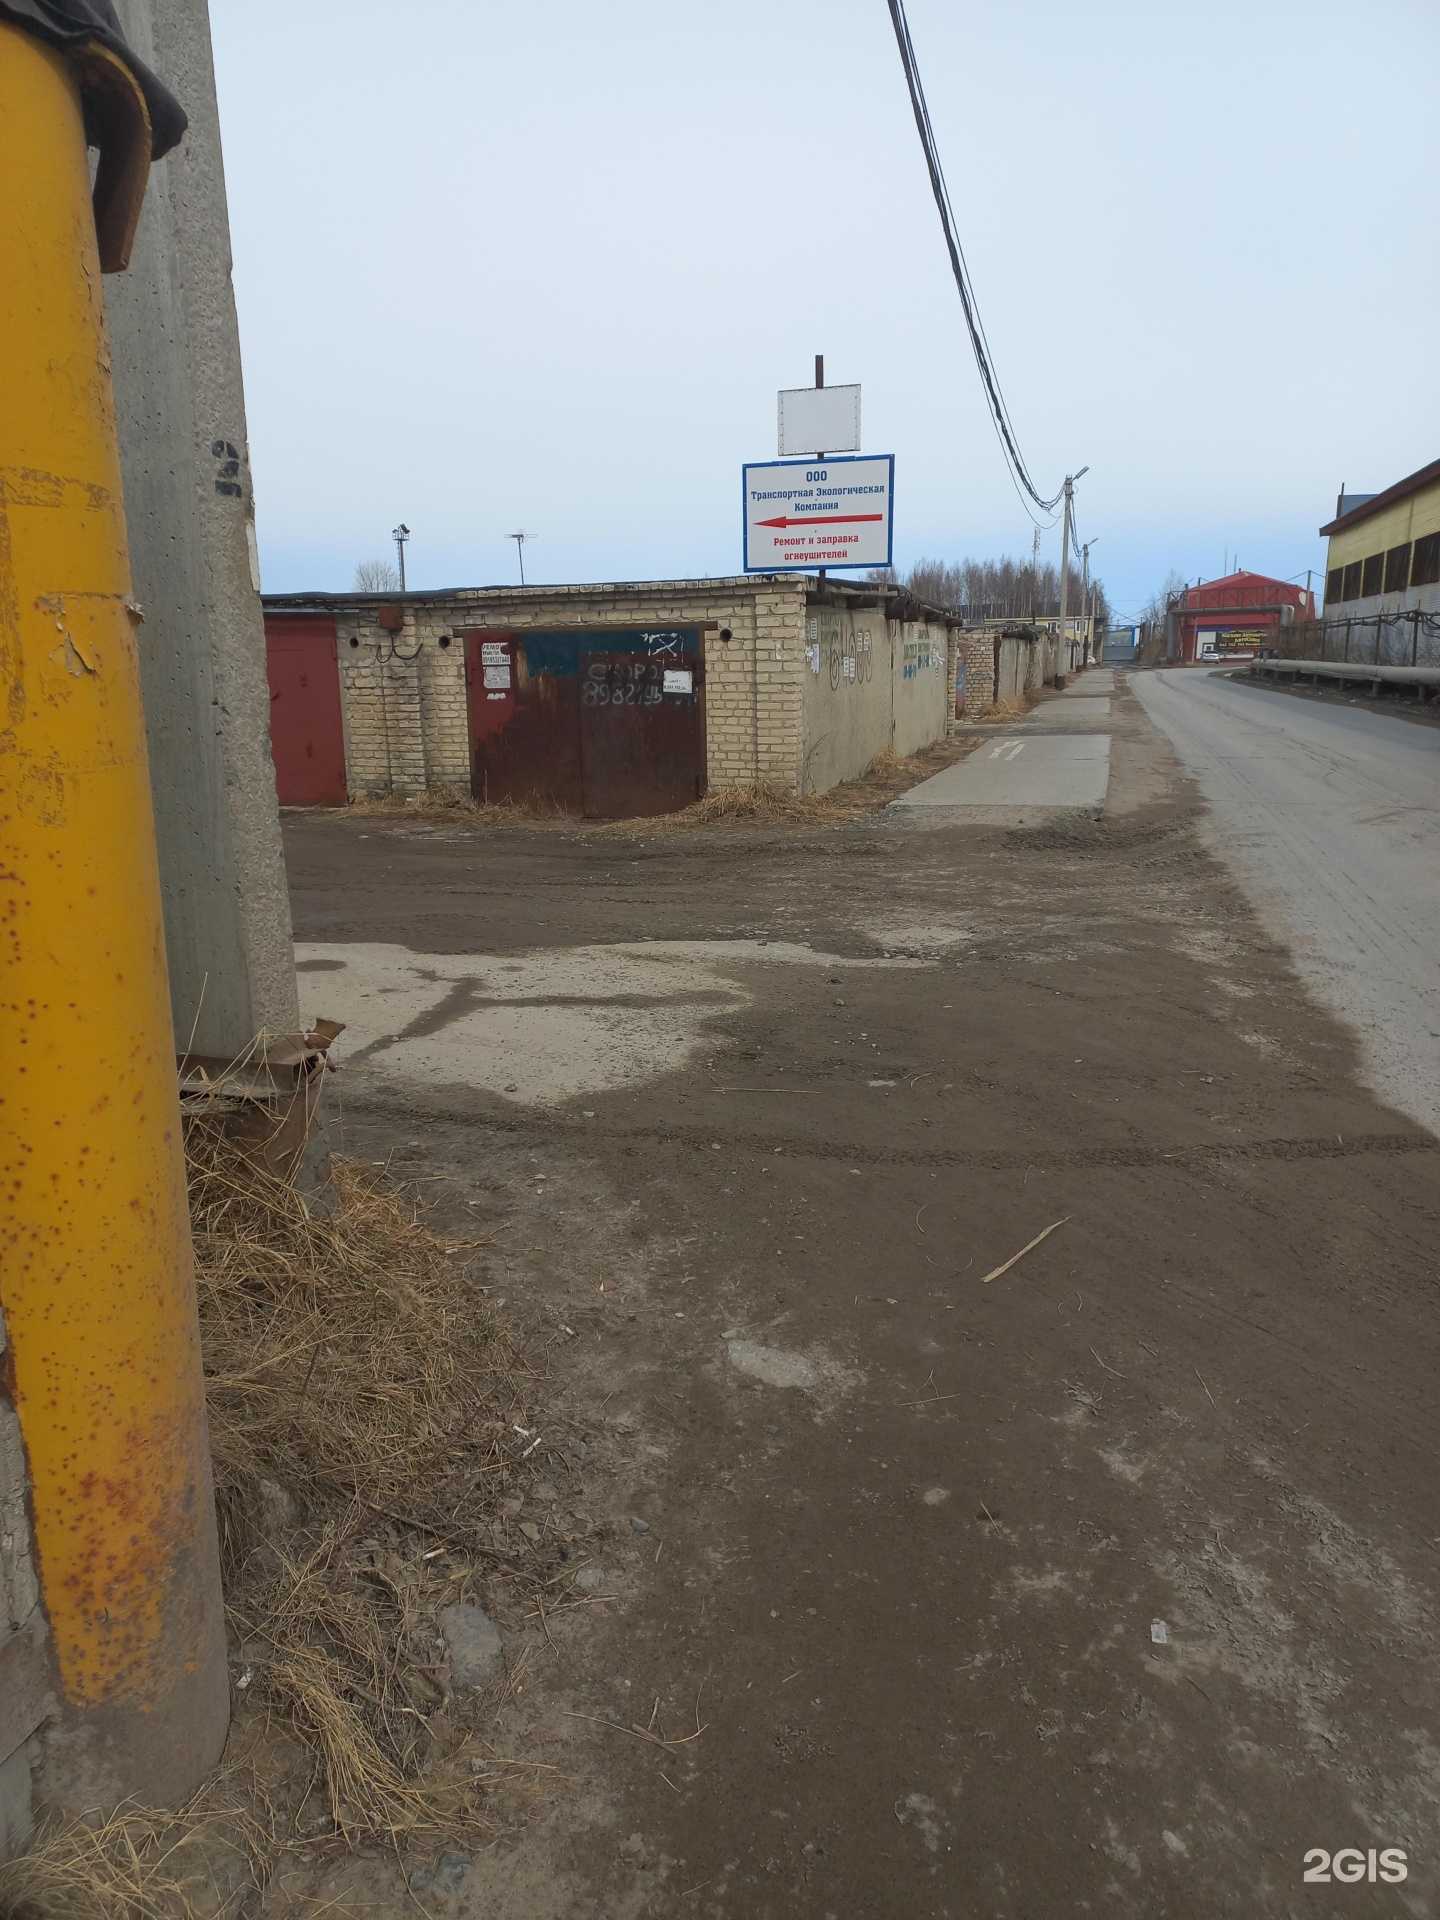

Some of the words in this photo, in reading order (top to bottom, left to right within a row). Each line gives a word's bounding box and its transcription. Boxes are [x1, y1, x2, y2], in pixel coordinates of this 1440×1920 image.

[806, 471, 827, 482] ООО
[750, 489, 813, 502] Транспортная
[816, 485, 885, 497] Экологическая
[794, 502, 839, 512] Компания
[773, 537, 806, 547] Ремонт
[808, 537, 814, 545] и
[816, 534, 859, 546] заправка
[784, 549, 848, 562] огнеушителей
